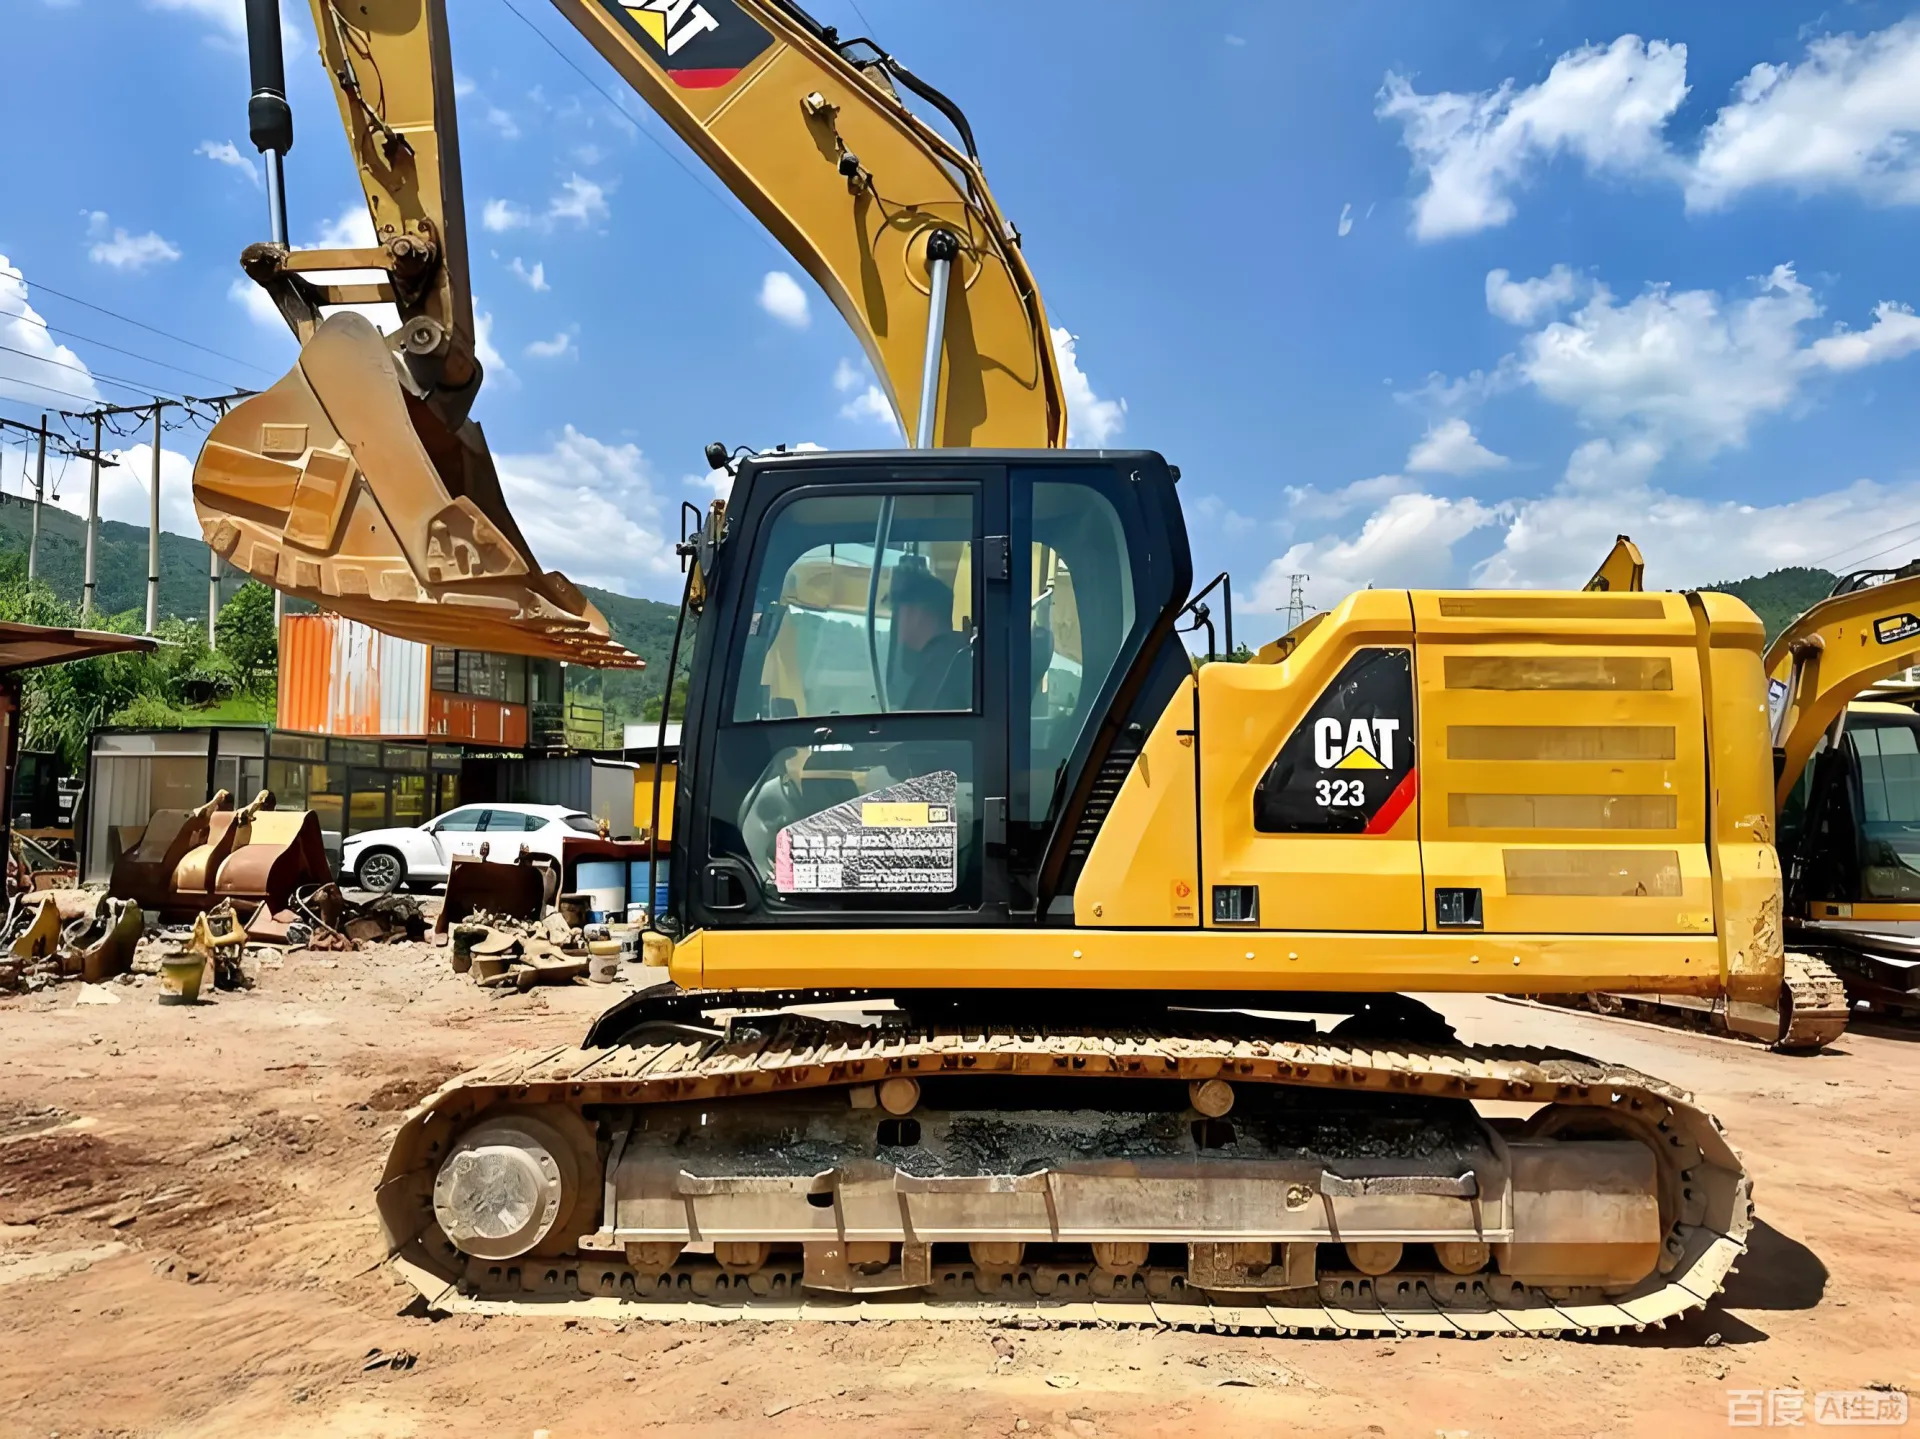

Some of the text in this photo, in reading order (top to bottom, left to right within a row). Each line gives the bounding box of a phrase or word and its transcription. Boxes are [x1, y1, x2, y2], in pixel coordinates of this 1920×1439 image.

[618, 0, 720, 56] AT
[1314, 717, 1400, 770] CAT
[1315, 779, 1365, 807] 323
